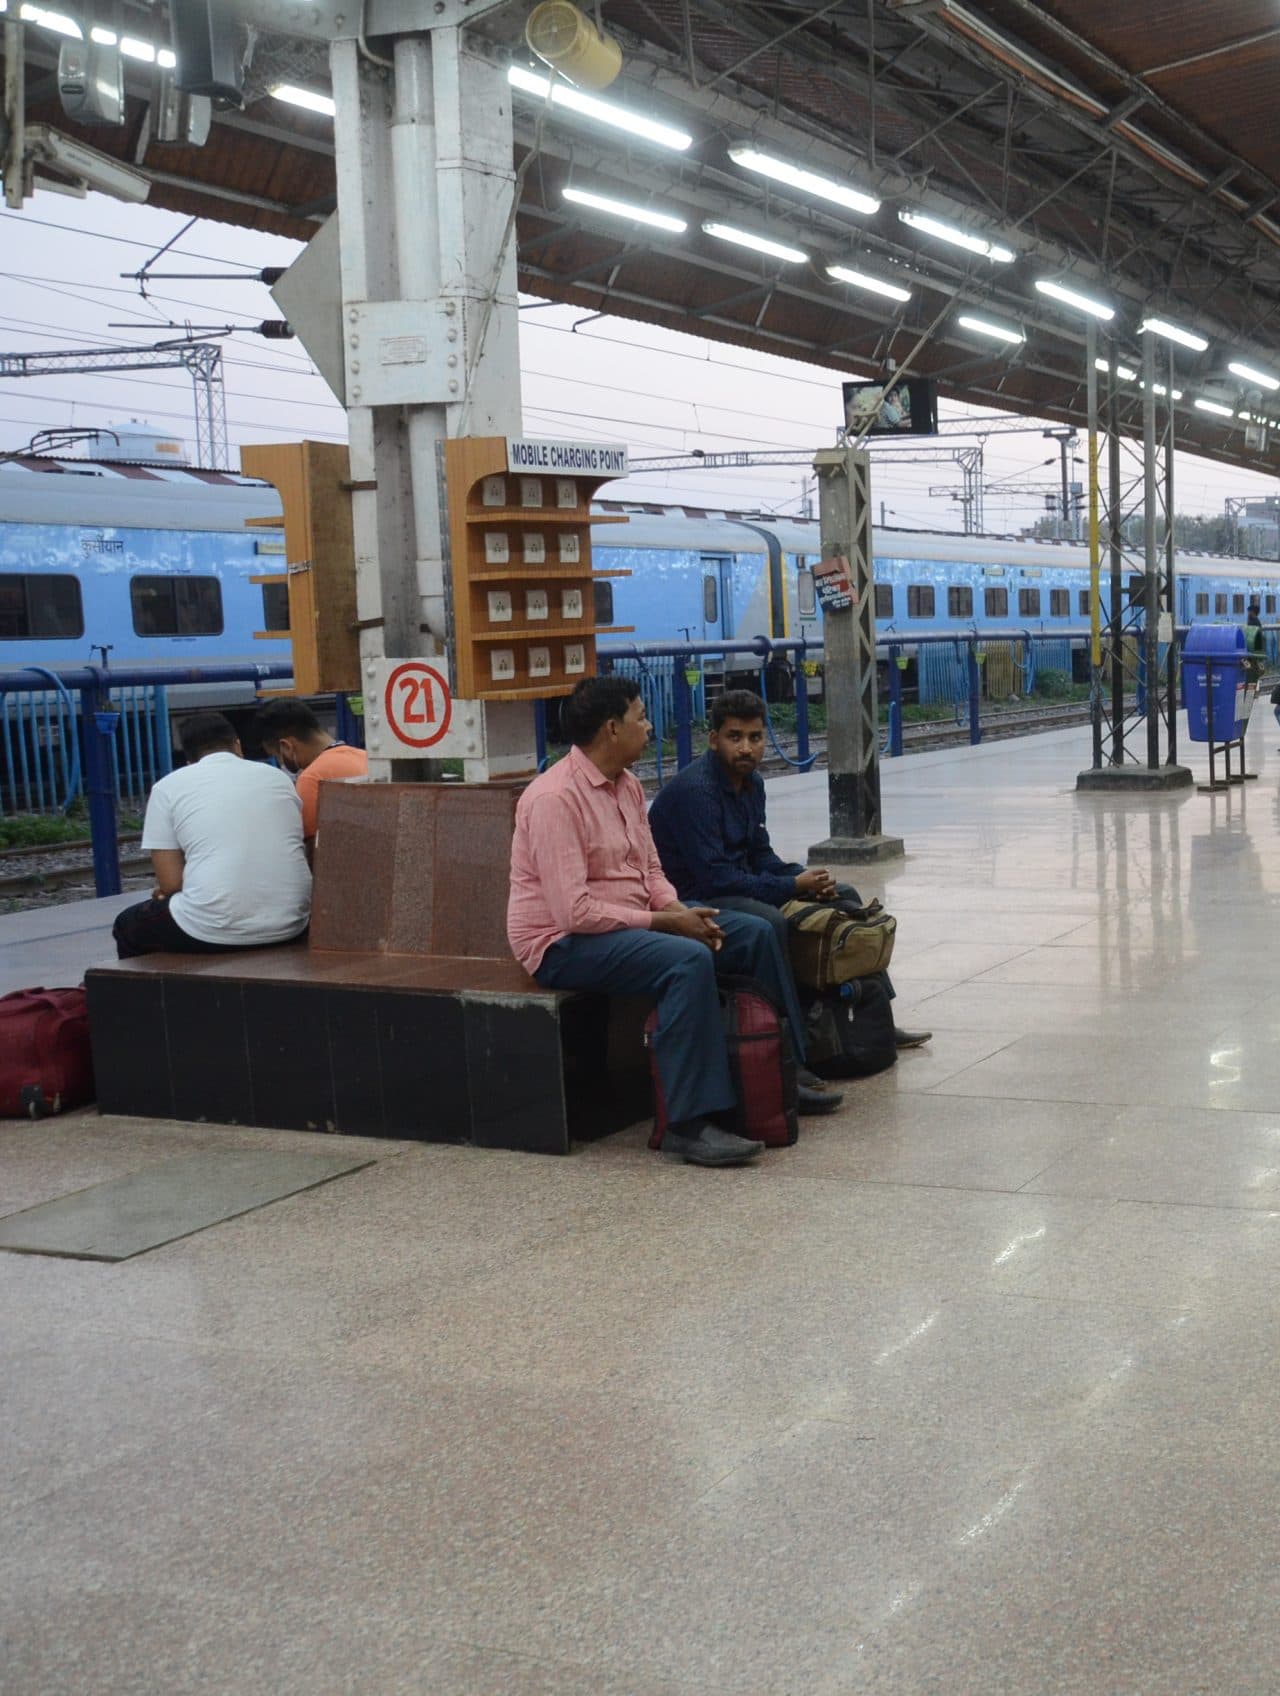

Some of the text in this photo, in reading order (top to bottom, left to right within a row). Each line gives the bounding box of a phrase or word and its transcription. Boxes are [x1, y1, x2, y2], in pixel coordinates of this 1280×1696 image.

[512, 443, 625, 472] MOBILE CHARGING POINT
[399, 677, 436, 723] 21
